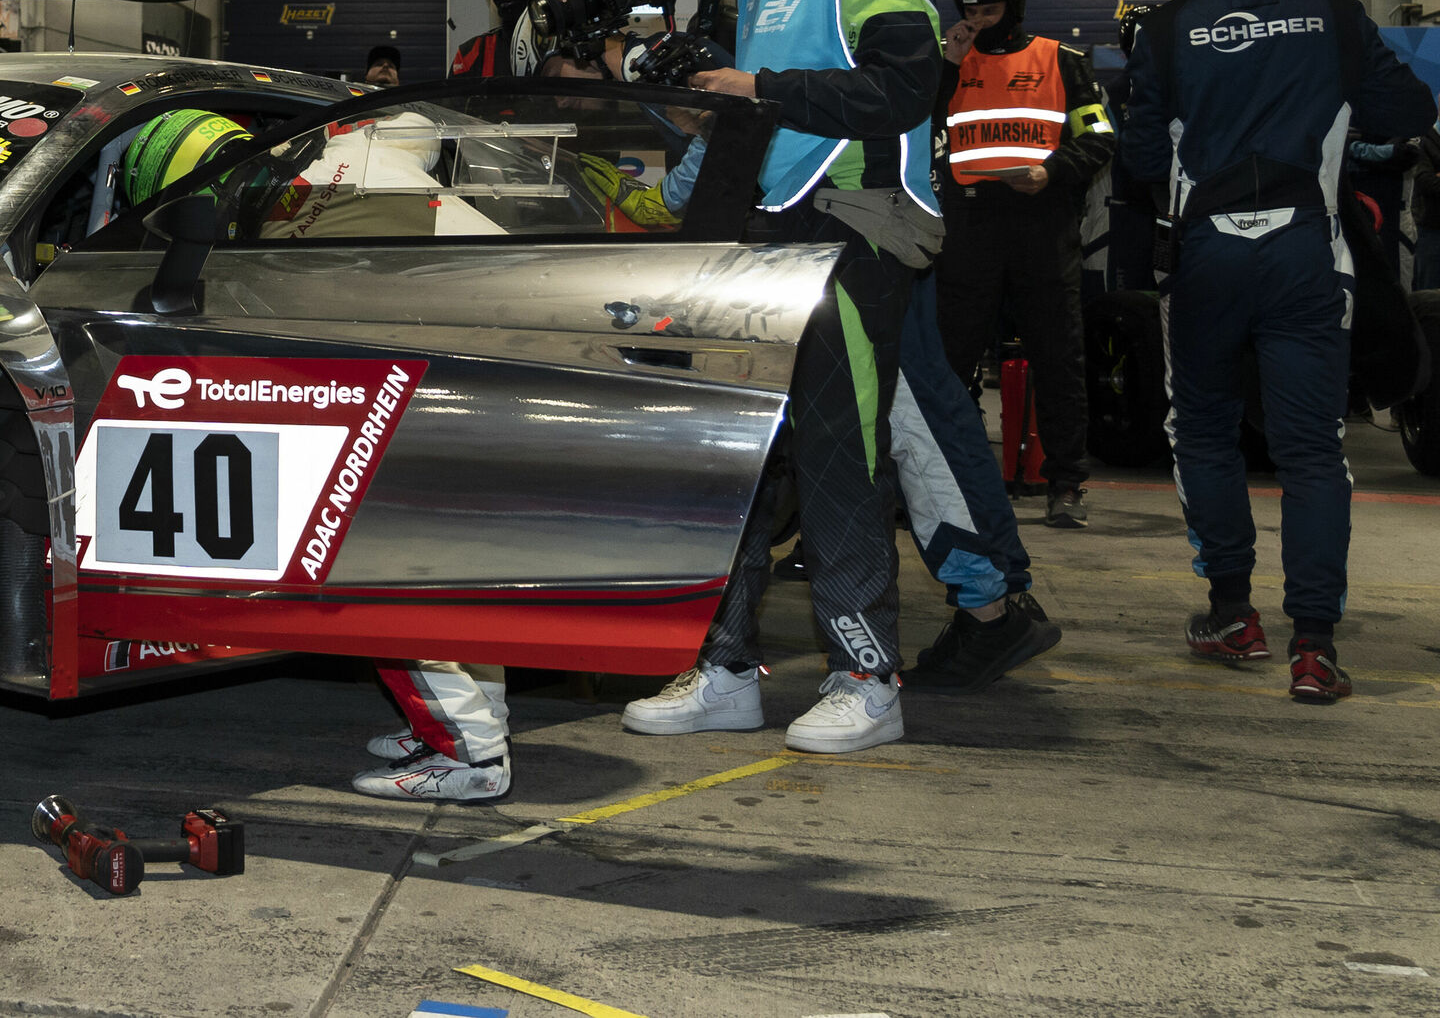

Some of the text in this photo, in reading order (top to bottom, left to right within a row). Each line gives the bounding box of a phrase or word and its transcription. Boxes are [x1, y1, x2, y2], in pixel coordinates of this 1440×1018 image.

[286, 9, 329, 22] HAZET
[1189, 17, 1325, 46] SCHERER
[959, 123, 1047, 146] PIT MARSHAL
[297, 162, 350, 235] Audi Sport
[195, 378, 366, 409] TotalEnergies
[300, 364, 412, 581] ADAC NORDRHEIN
[118, 433, 255, 560] 40
[837, 615, 880, 669] OMP
[112, 853, 120, 888] FUEL
